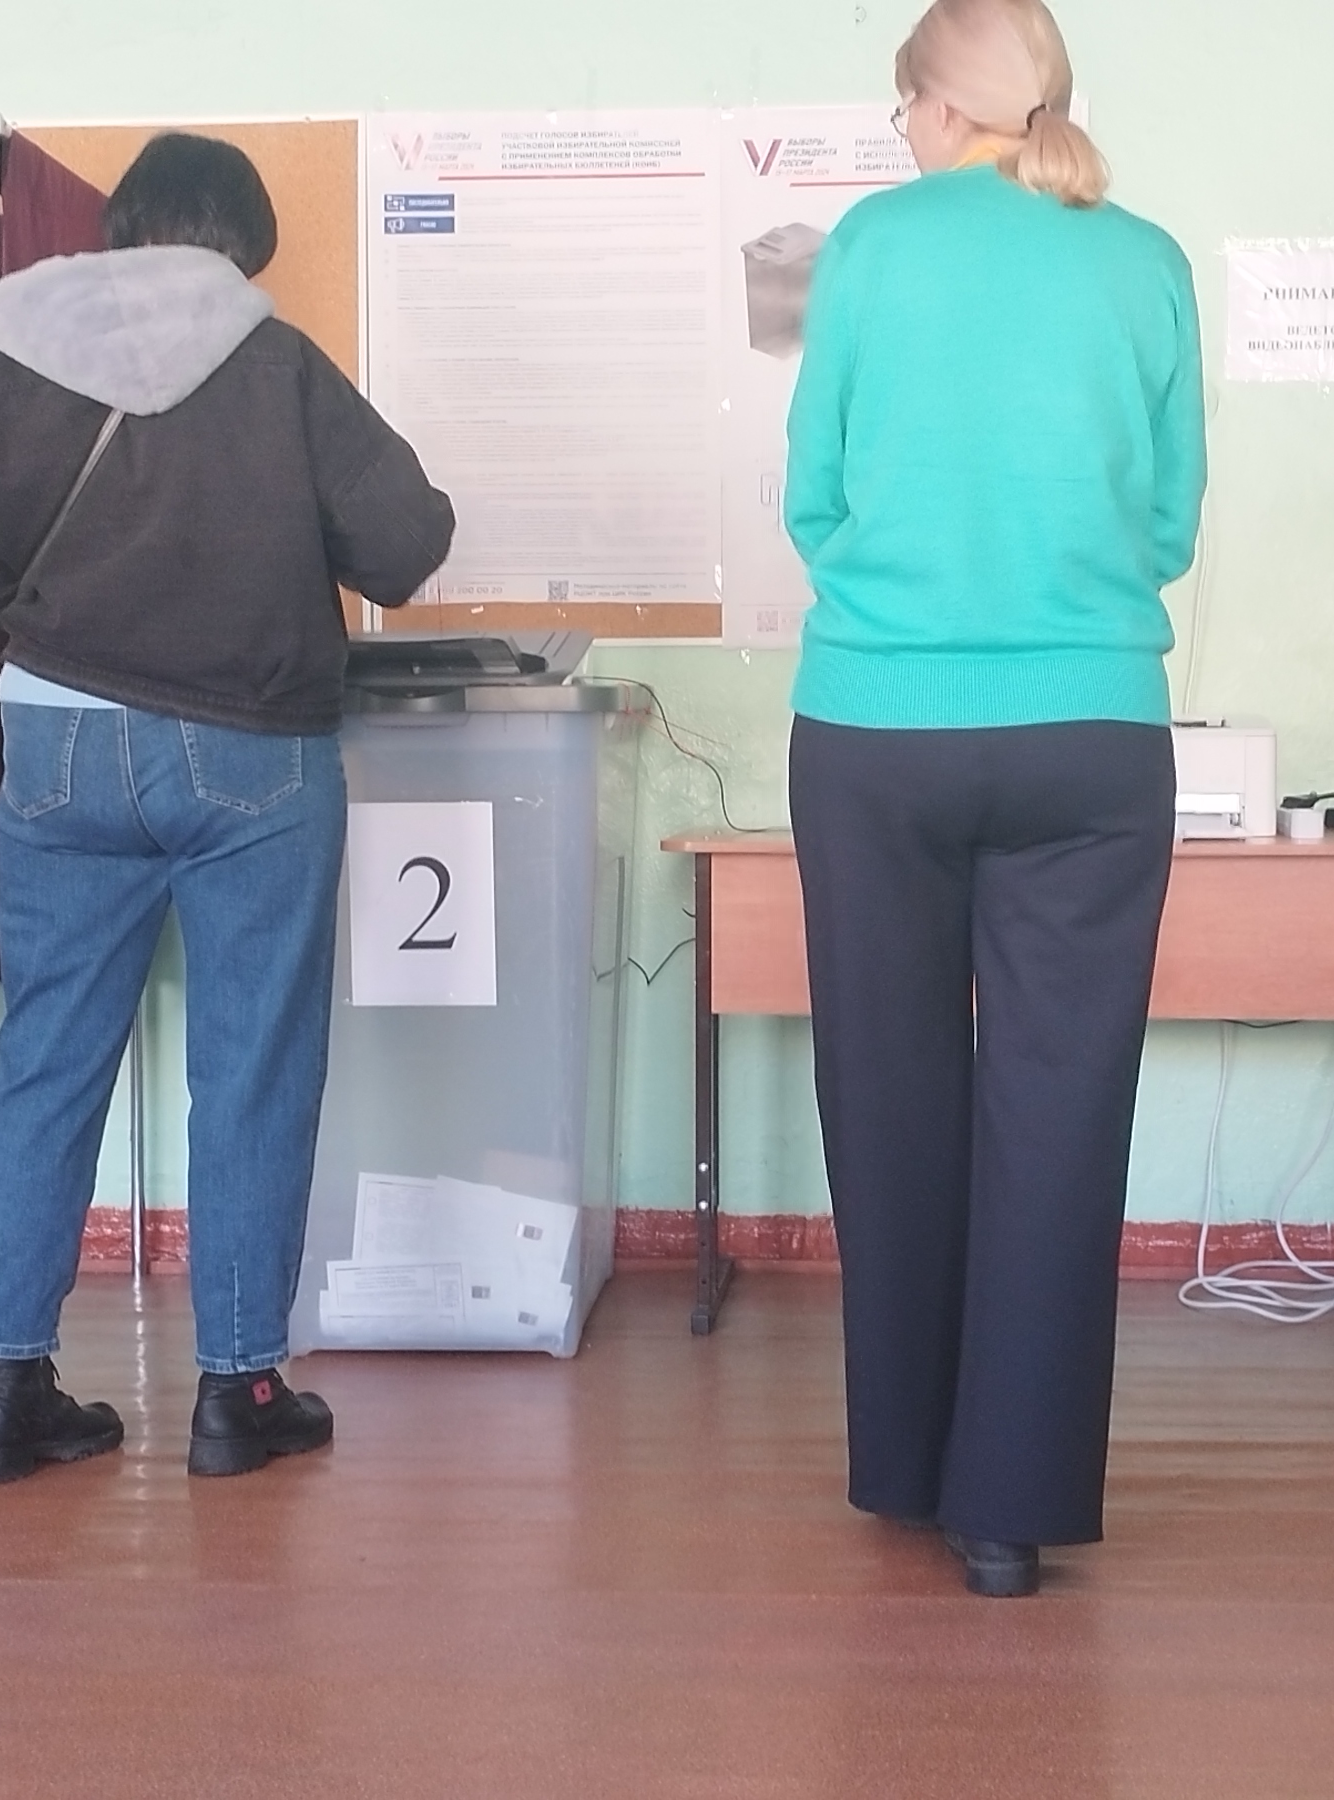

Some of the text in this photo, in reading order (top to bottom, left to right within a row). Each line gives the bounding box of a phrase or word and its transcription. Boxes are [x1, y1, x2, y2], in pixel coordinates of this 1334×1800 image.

[787, 137, 826, 146] ВЫБОРЫ
[782, 147, 838, 157] ПРЕЗИДЕНТА
[778, 158, 814, 167] РОССИИ
[398, 856, 457, 950] 2
